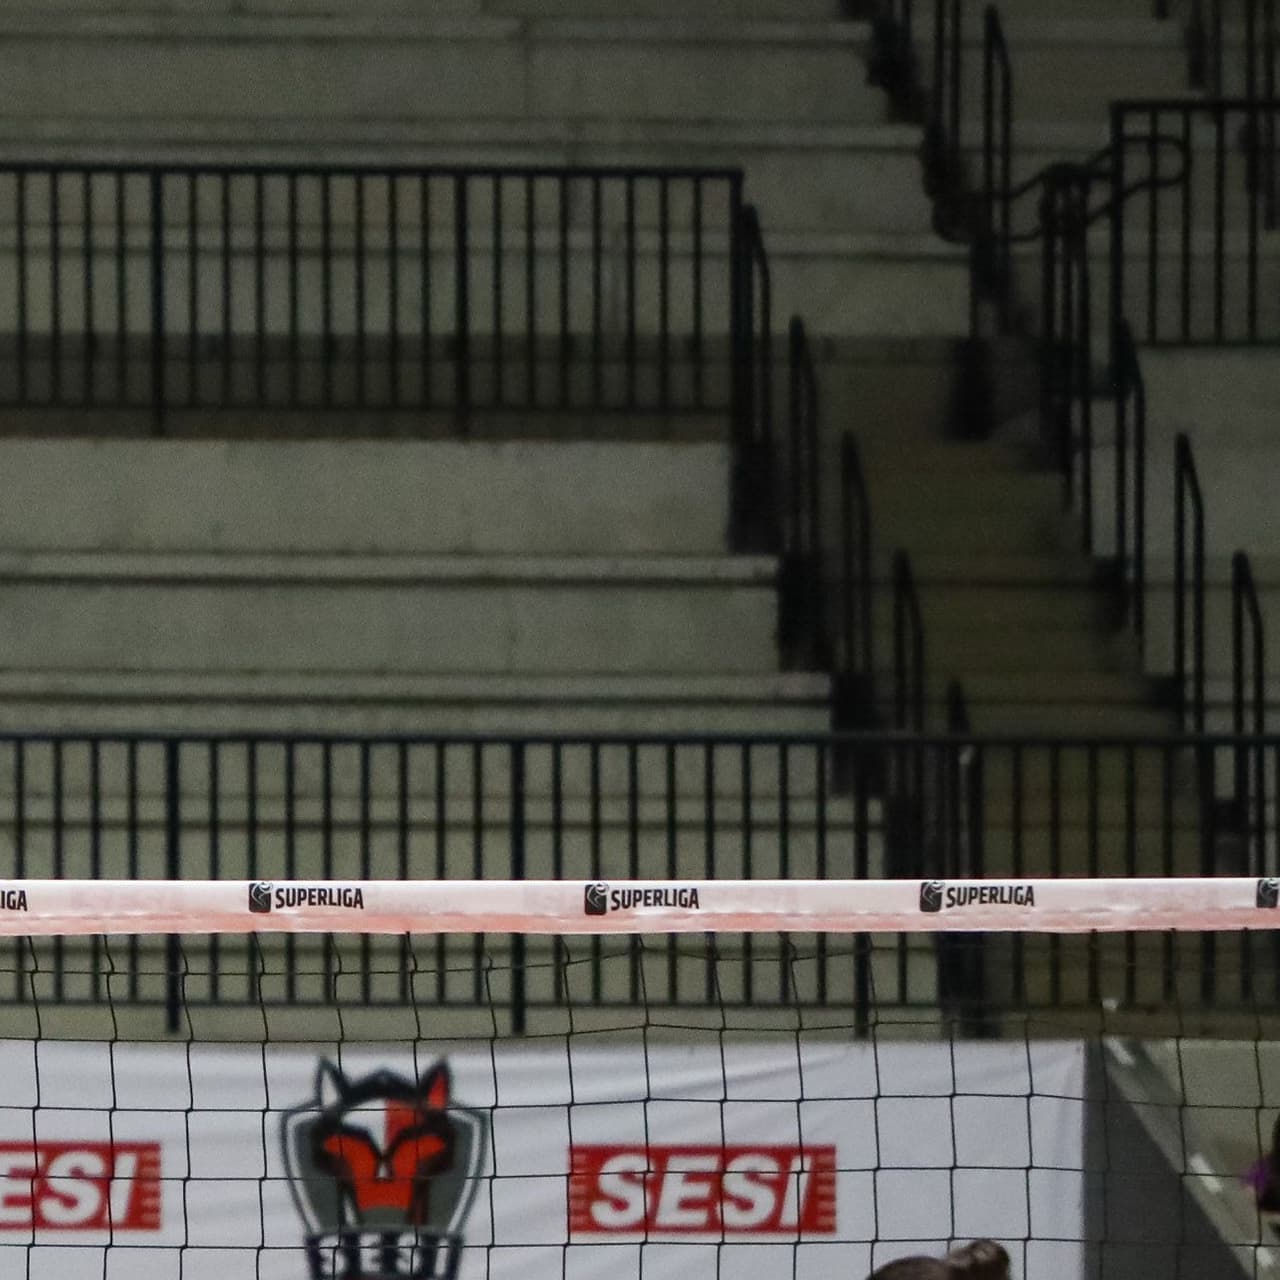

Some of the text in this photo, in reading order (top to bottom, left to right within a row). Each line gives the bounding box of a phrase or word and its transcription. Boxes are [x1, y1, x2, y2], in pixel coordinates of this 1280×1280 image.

[275, 886, 364, 910] SUPERLIGA
[610, 886, 700, 911] SUPERLIGA
[945, 883, 1035, 908] SUPERLIGA
[590, 1152, 813, 1229] SESI
[319, 1232, 449, 1279] SESI
